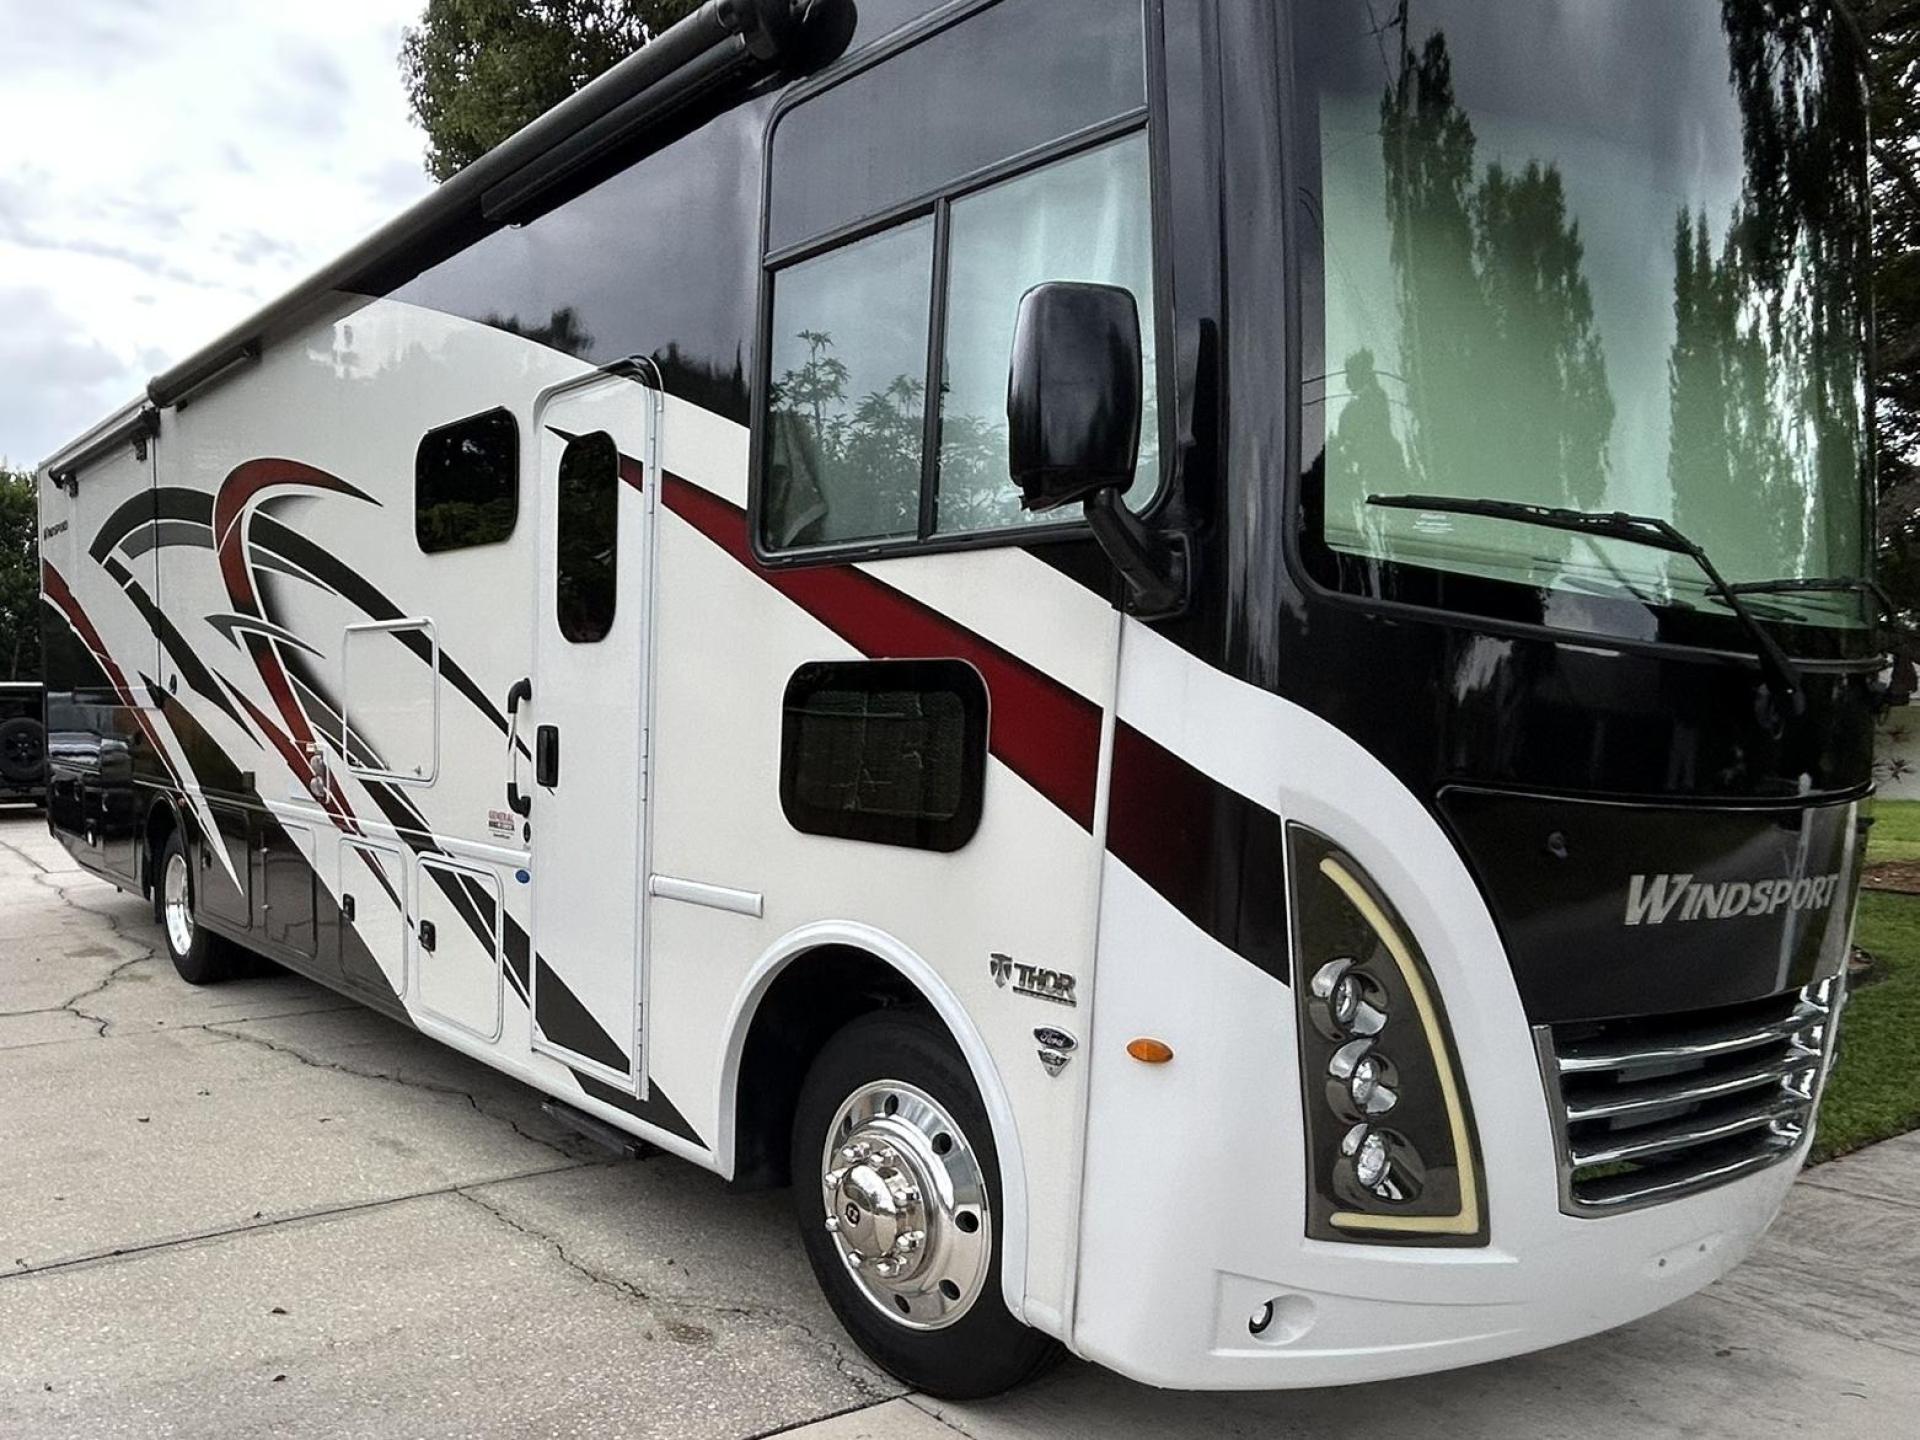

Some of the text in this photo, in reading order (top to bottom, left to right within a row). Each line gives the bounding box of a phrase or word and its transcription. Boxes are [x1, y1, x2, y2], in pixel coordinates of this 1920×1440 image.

[1624, 873, 1839, 926] WINDSPORT
[1013, 962, 1077, 1000] THOR
[1040, 1030, 1066, 1046] Ford
